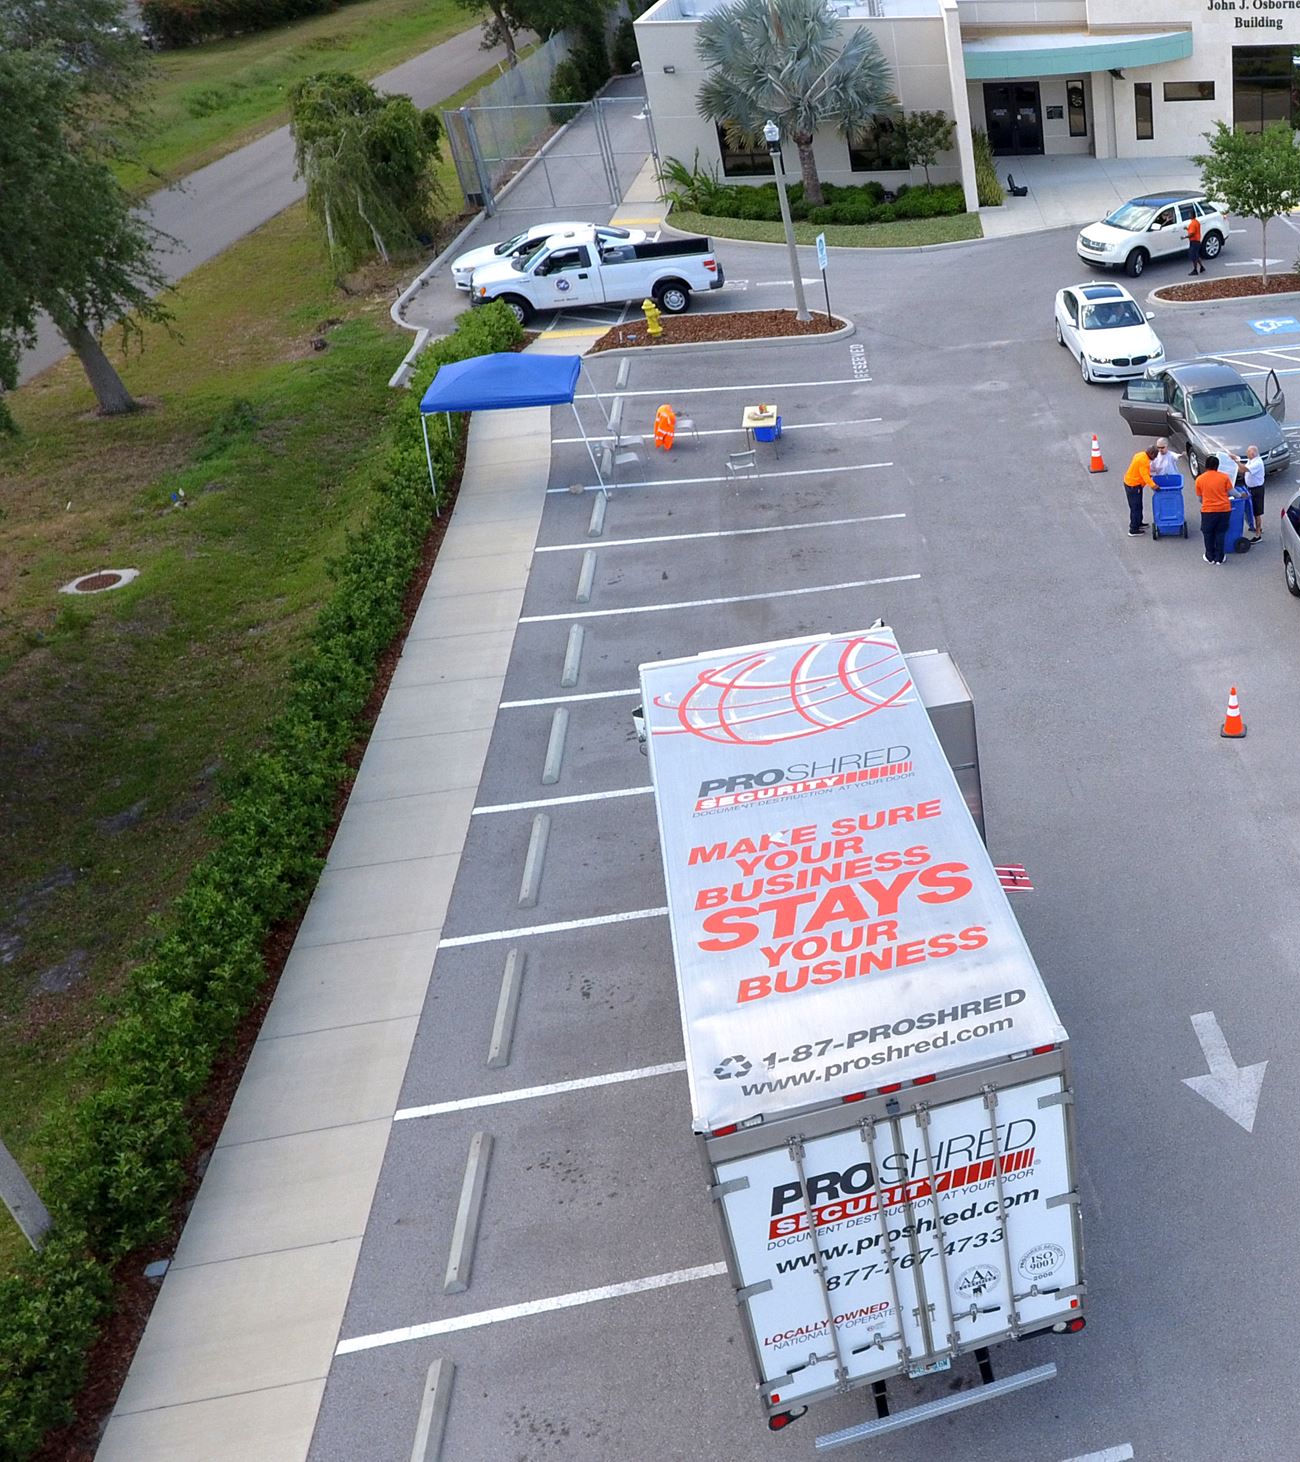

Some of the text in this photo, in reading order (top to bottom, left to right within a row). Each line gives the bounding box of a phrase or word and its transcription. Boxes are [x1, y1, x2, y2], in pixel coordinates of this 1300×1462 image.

[1208, 0, 1235, 10] John
[1239, 0, 1249, 10] J.
[1234, 16, 1283, 30] Building
[692, 803, 758, 818] DOCUMENT
[759, 788, 833, 806] DESTRUCTION
[854, 778, 884, 789] YOUR
[885, 772, 915, 783] DOOR
[698, 745, 911, 798] PROSHRED
[700, 776, 840, 810] SECURITY
[687, 799, 942, 866] MAKE SURE
[736, 836, 864, 877] YOUR
[694, 845, 932, 911] BUSINESS
[697, 862, 973, 952] STAYS
[736, 926, 989, 1003] BUSINESS
[760, 920, 897, 968] YOUR
[741, 1017, 1014, 1097] www.proshred.com
[762, 989, 1026, 1070] 1-87-PROSHRED
[771, 1118, 1036, 1217] PROSHRED
[767, 1222, 843, 1250] DOCUMENT
[943, 1190, 959, 1201] AT
[961, 1180, 996, 1195] YOUR
[1000, 1168, 1035, 1185] DOOR
[776, 1173, 947, 1234] SECURITY
[776, 1188, 1040, 1274] www.proshred.com
[826, 1228, 1004, 1291] 877-767-4733
[1029, 1258, 1054, 1270] 9001
[1031, 1251, 1053, 1263] ISO
[764, 1301, 890, 1346] LOCALLY OWNED
[773, 1324, 844, 1351] NATIONALY
